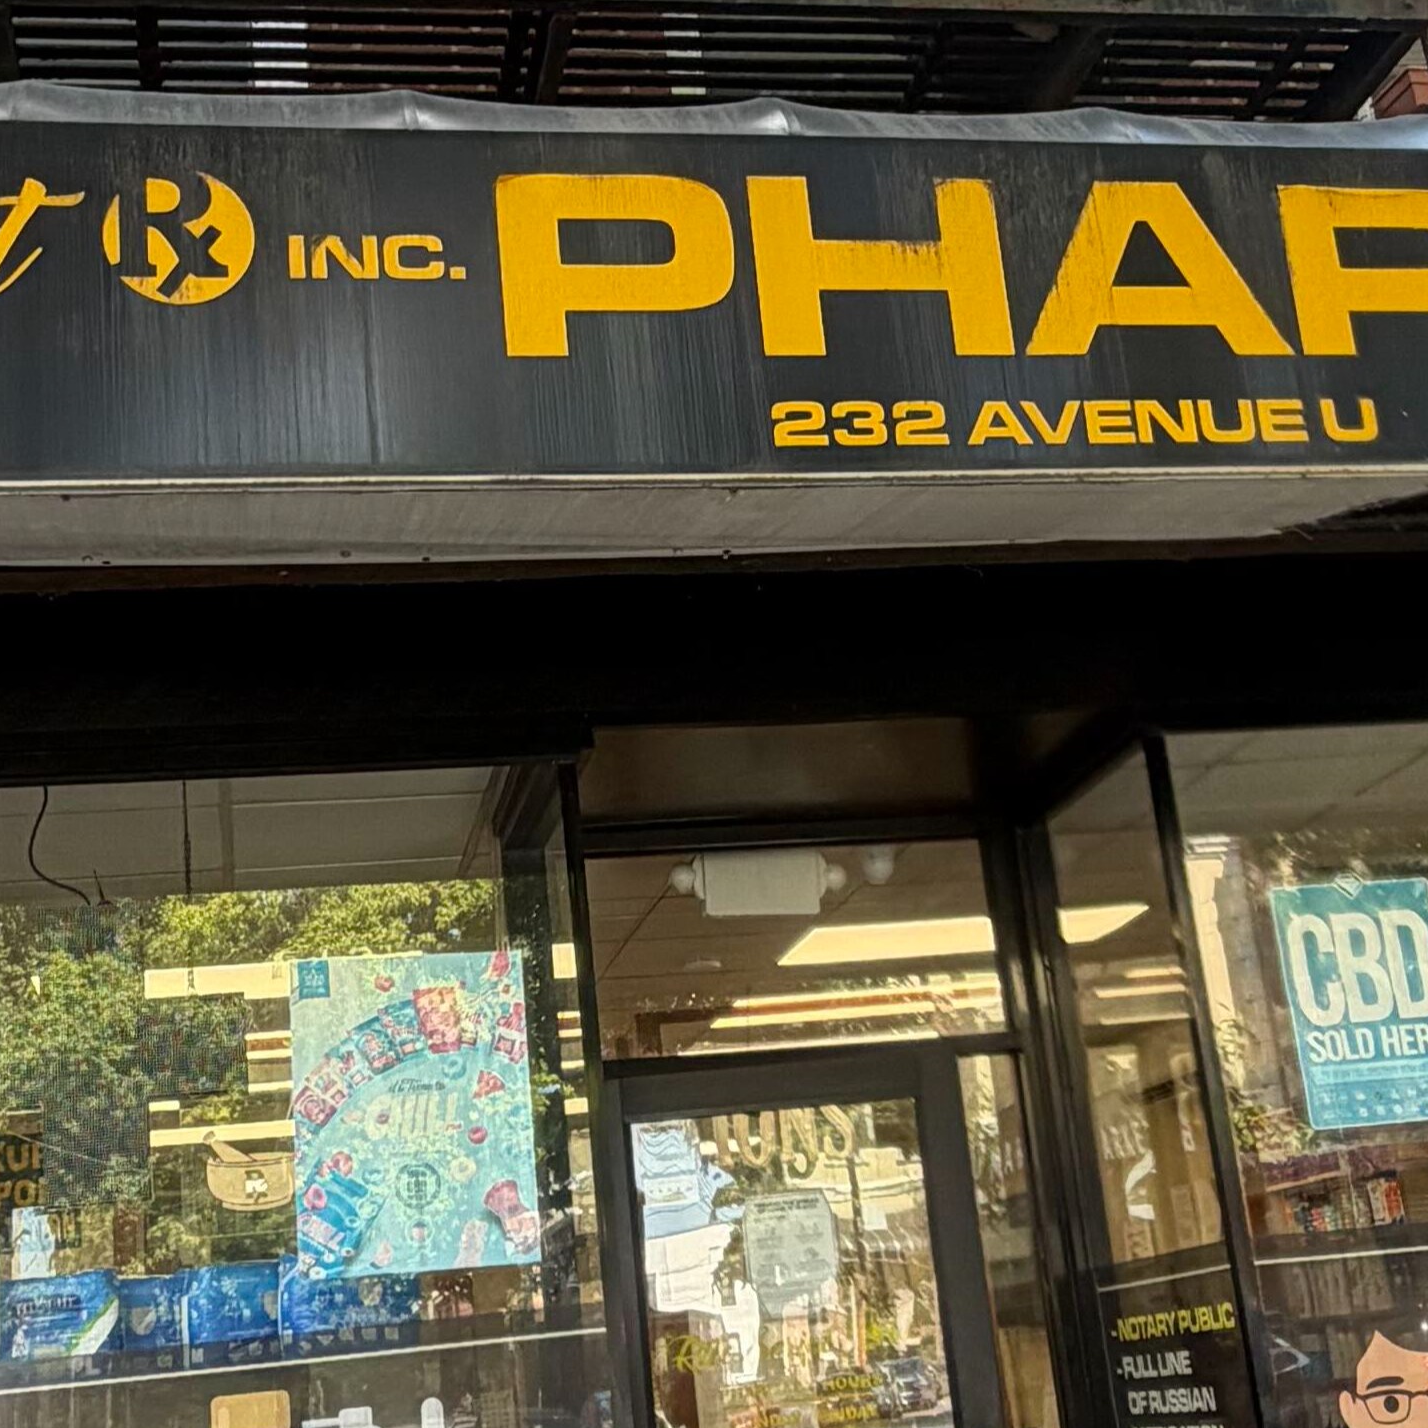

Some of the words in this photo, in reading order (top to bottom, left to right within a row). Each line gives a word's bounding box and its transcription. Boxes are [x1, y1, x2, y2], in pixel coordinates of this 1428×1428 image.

[288, 234, 468, 280] INC.
[770, 399, 951, 448] 232
[967, 398, 1310, 446] AVENUE
[1322, 397, 1378, 442] U
[1306, 1027, 1376, 1063] SOLD
[1177, 1302, 1236, 1337] PUBLIC
[1158, 1350, 1193, 1376] LINE
[1128, 1391, 1147, 1415] OF
[1150, 1386, 1217, 1414] RUSSIAN
